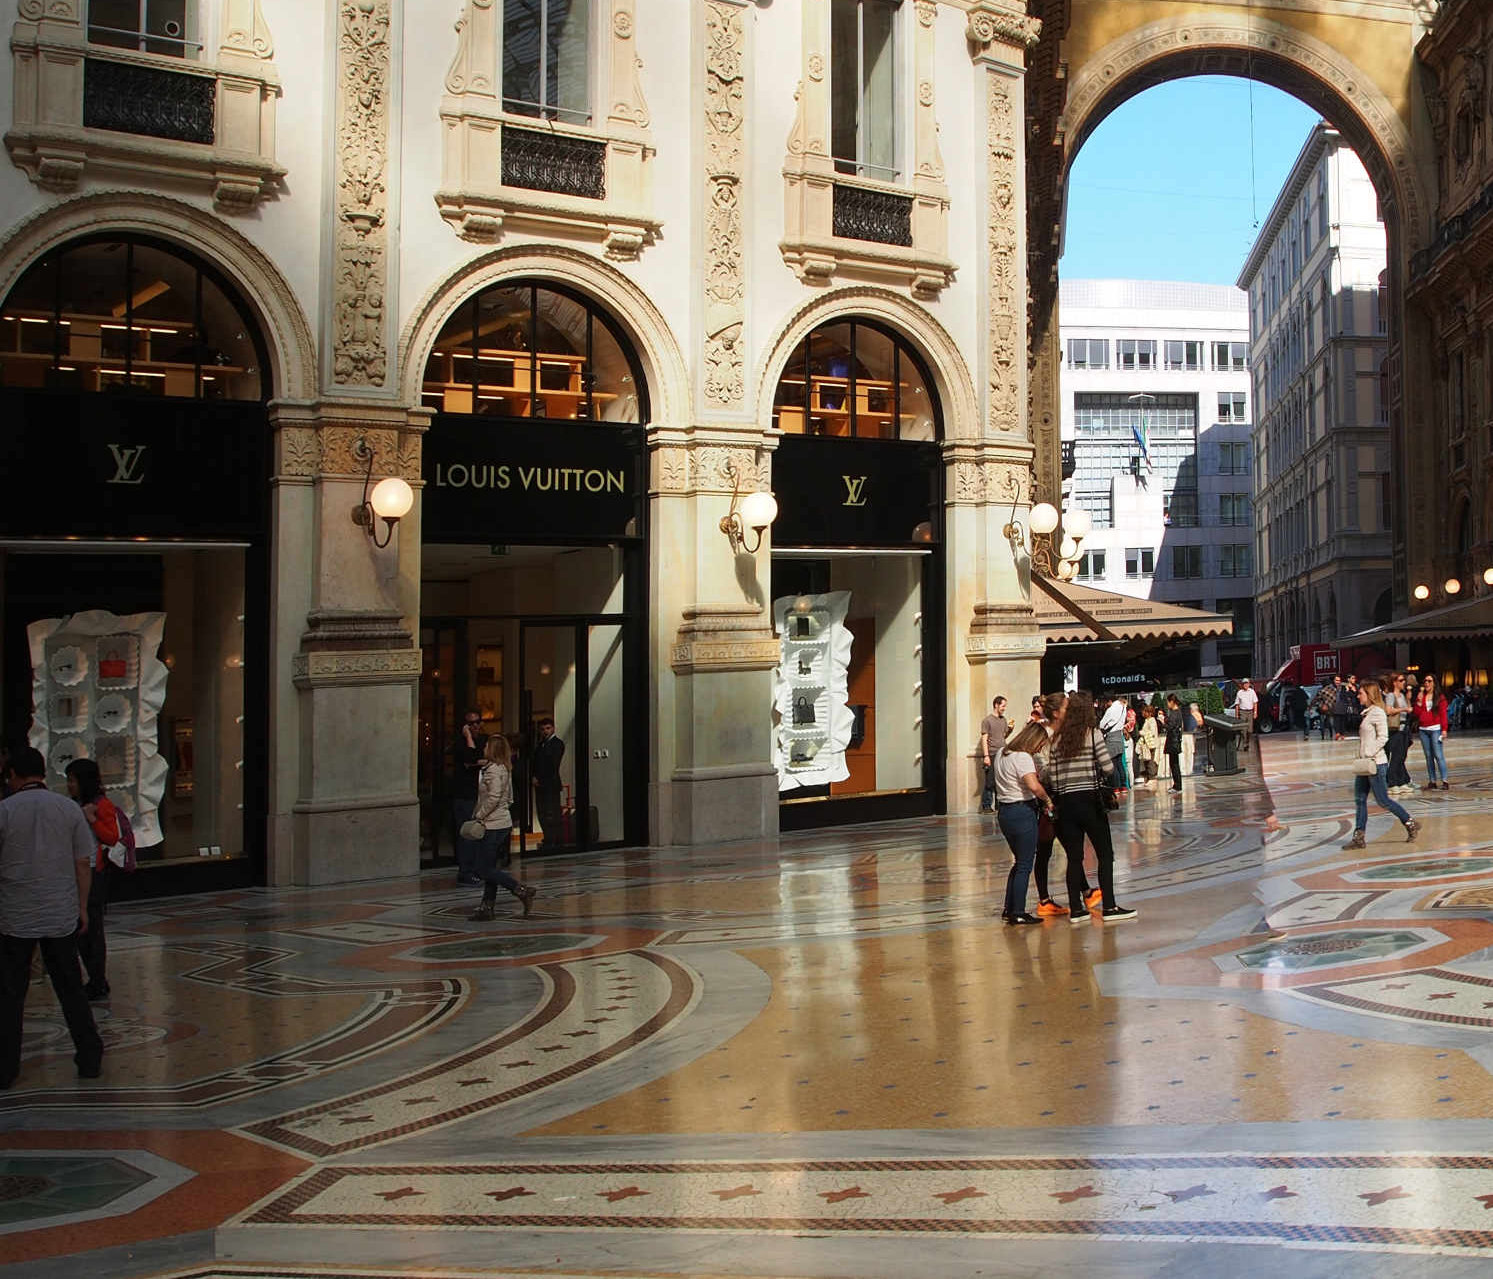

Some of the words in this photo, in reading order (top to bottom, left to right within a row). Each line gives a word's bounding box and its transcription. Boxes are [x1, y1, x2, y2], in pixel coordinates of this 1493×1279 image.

[436, 463, 511, 489] LOUIS
[518, 466, 625, 494] VUITTON
[1316, 655, 1337, 670] BRT
